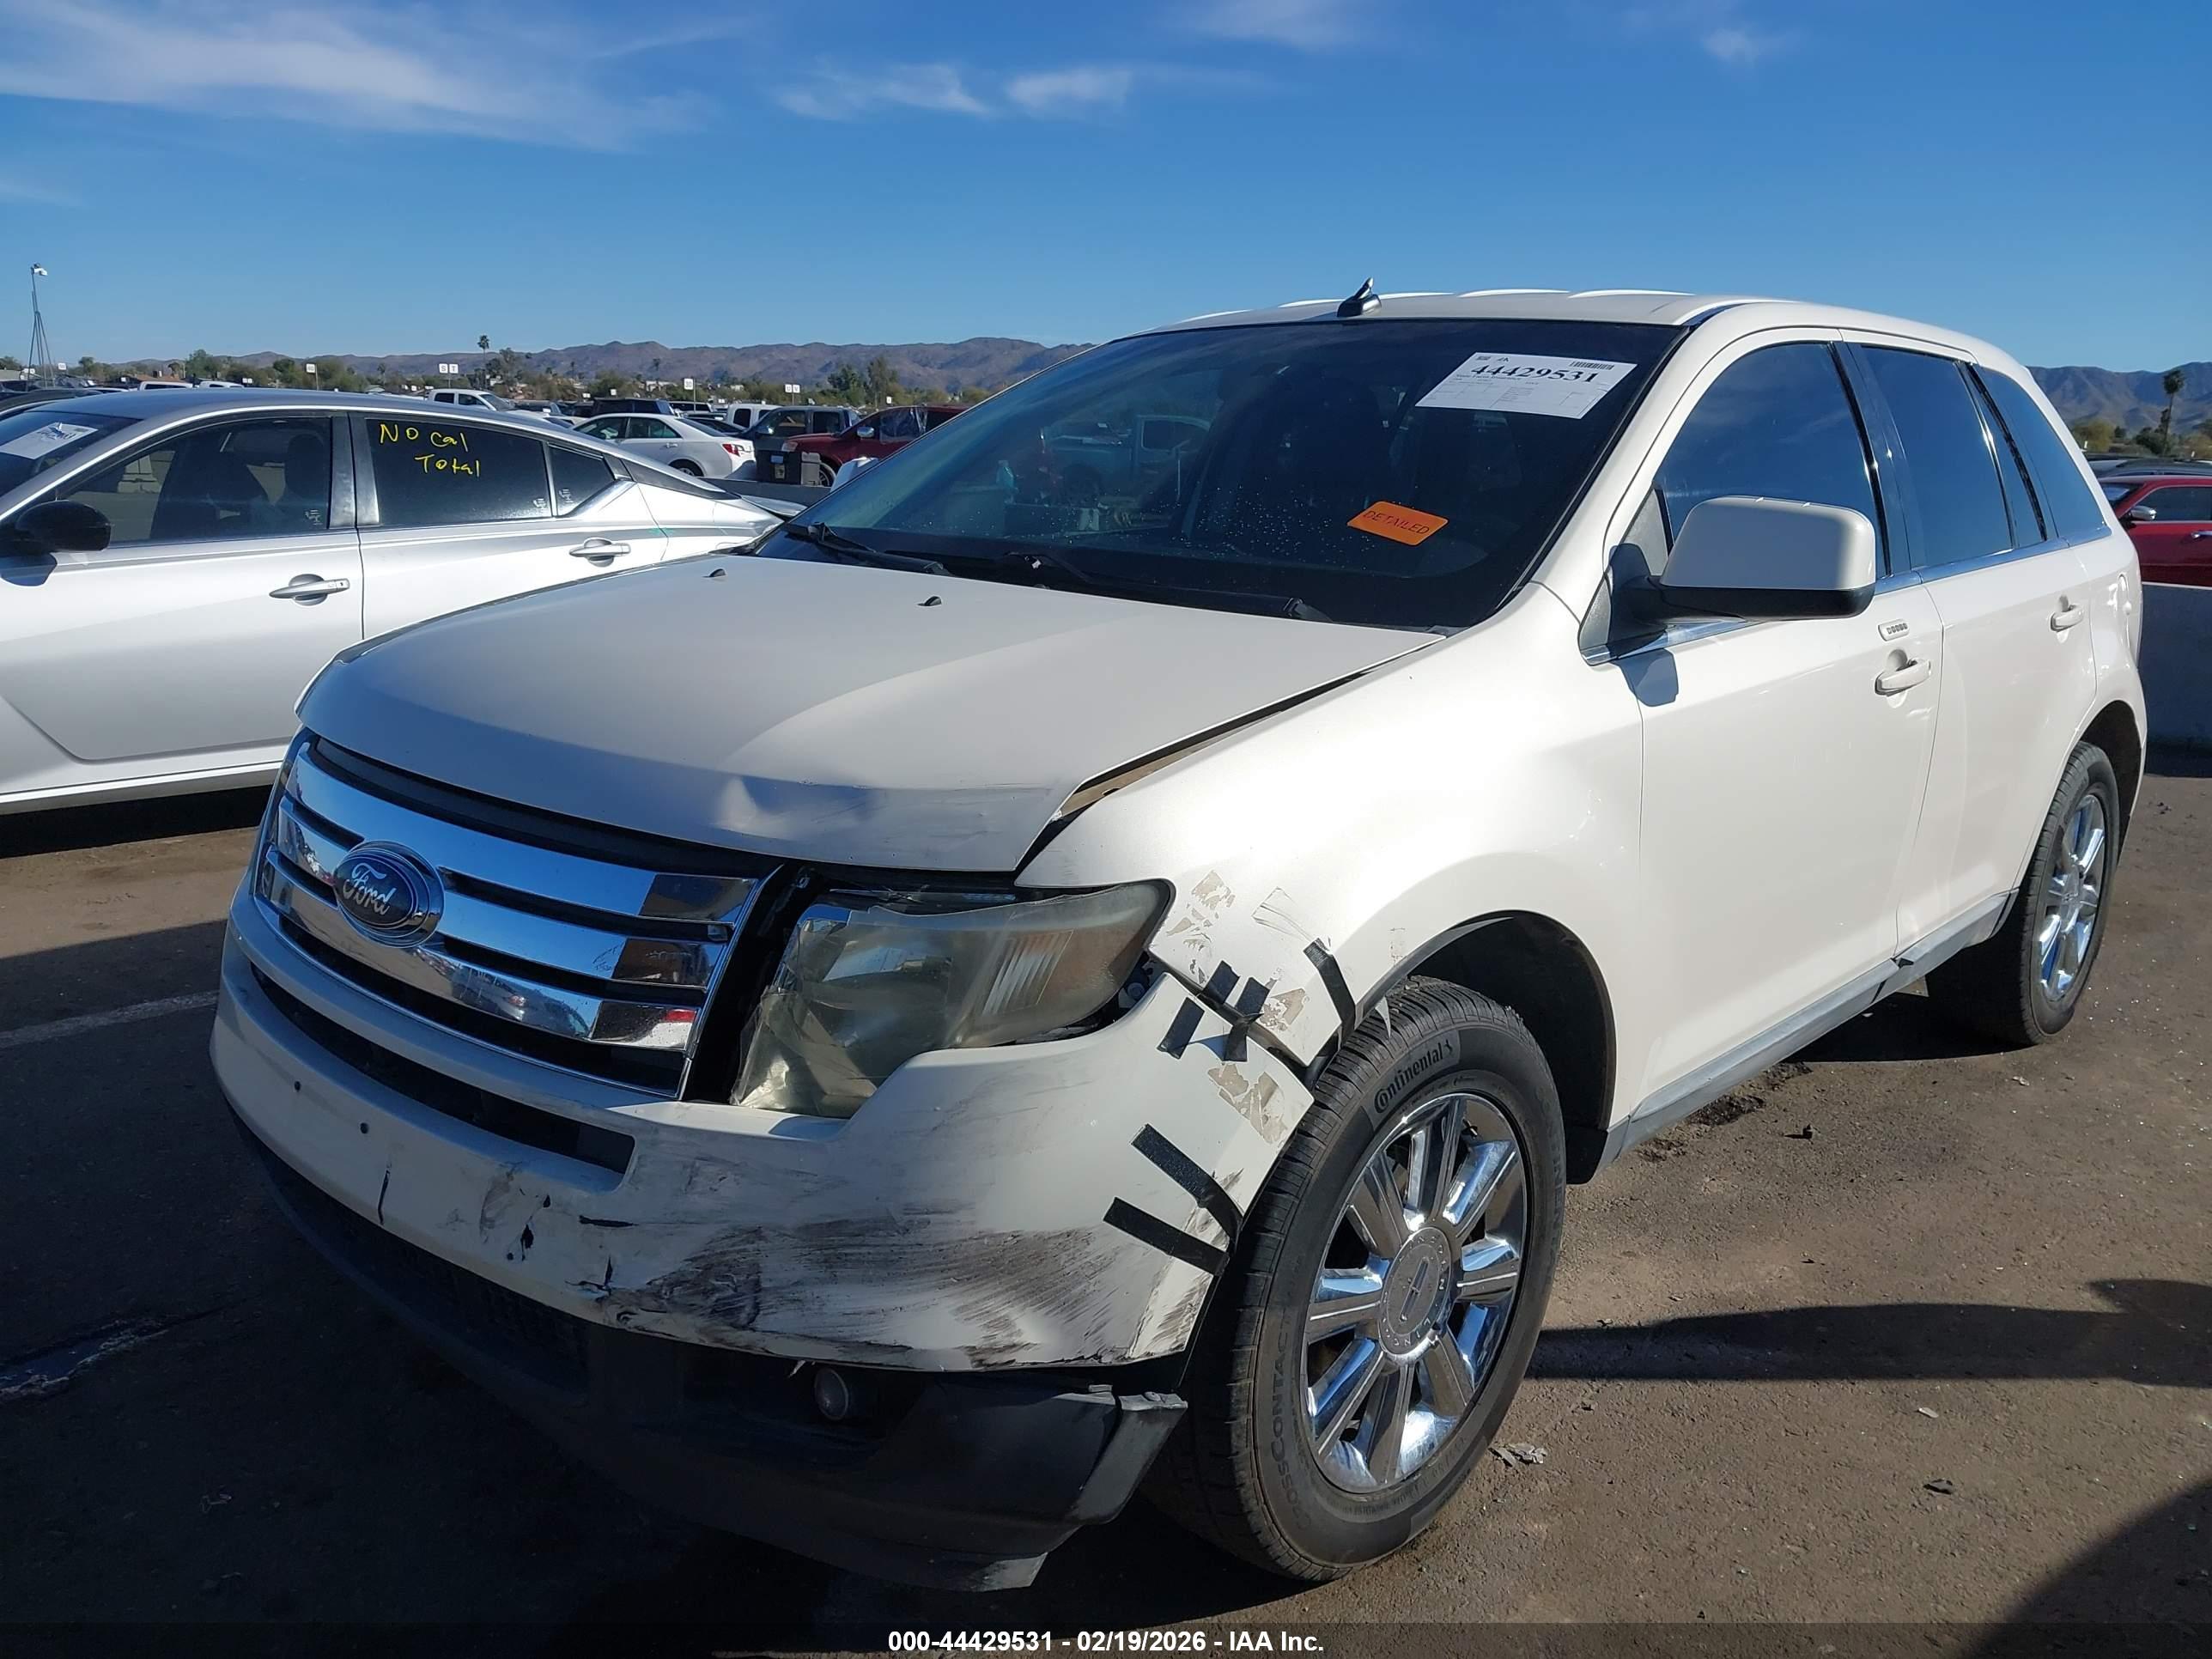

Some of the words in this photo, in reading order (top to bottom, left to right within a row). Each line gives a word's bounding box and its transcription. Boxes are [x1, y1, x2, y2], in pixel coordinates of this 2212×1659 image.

[1471, 364, 1601, 383] 44429531
[414, 453, 480, 477] Total
[1363, 510, 1431, 534] DETAILED
[343, 862, 397, 915] Ford
[1374, 1042, 1443, 1114] Continental
